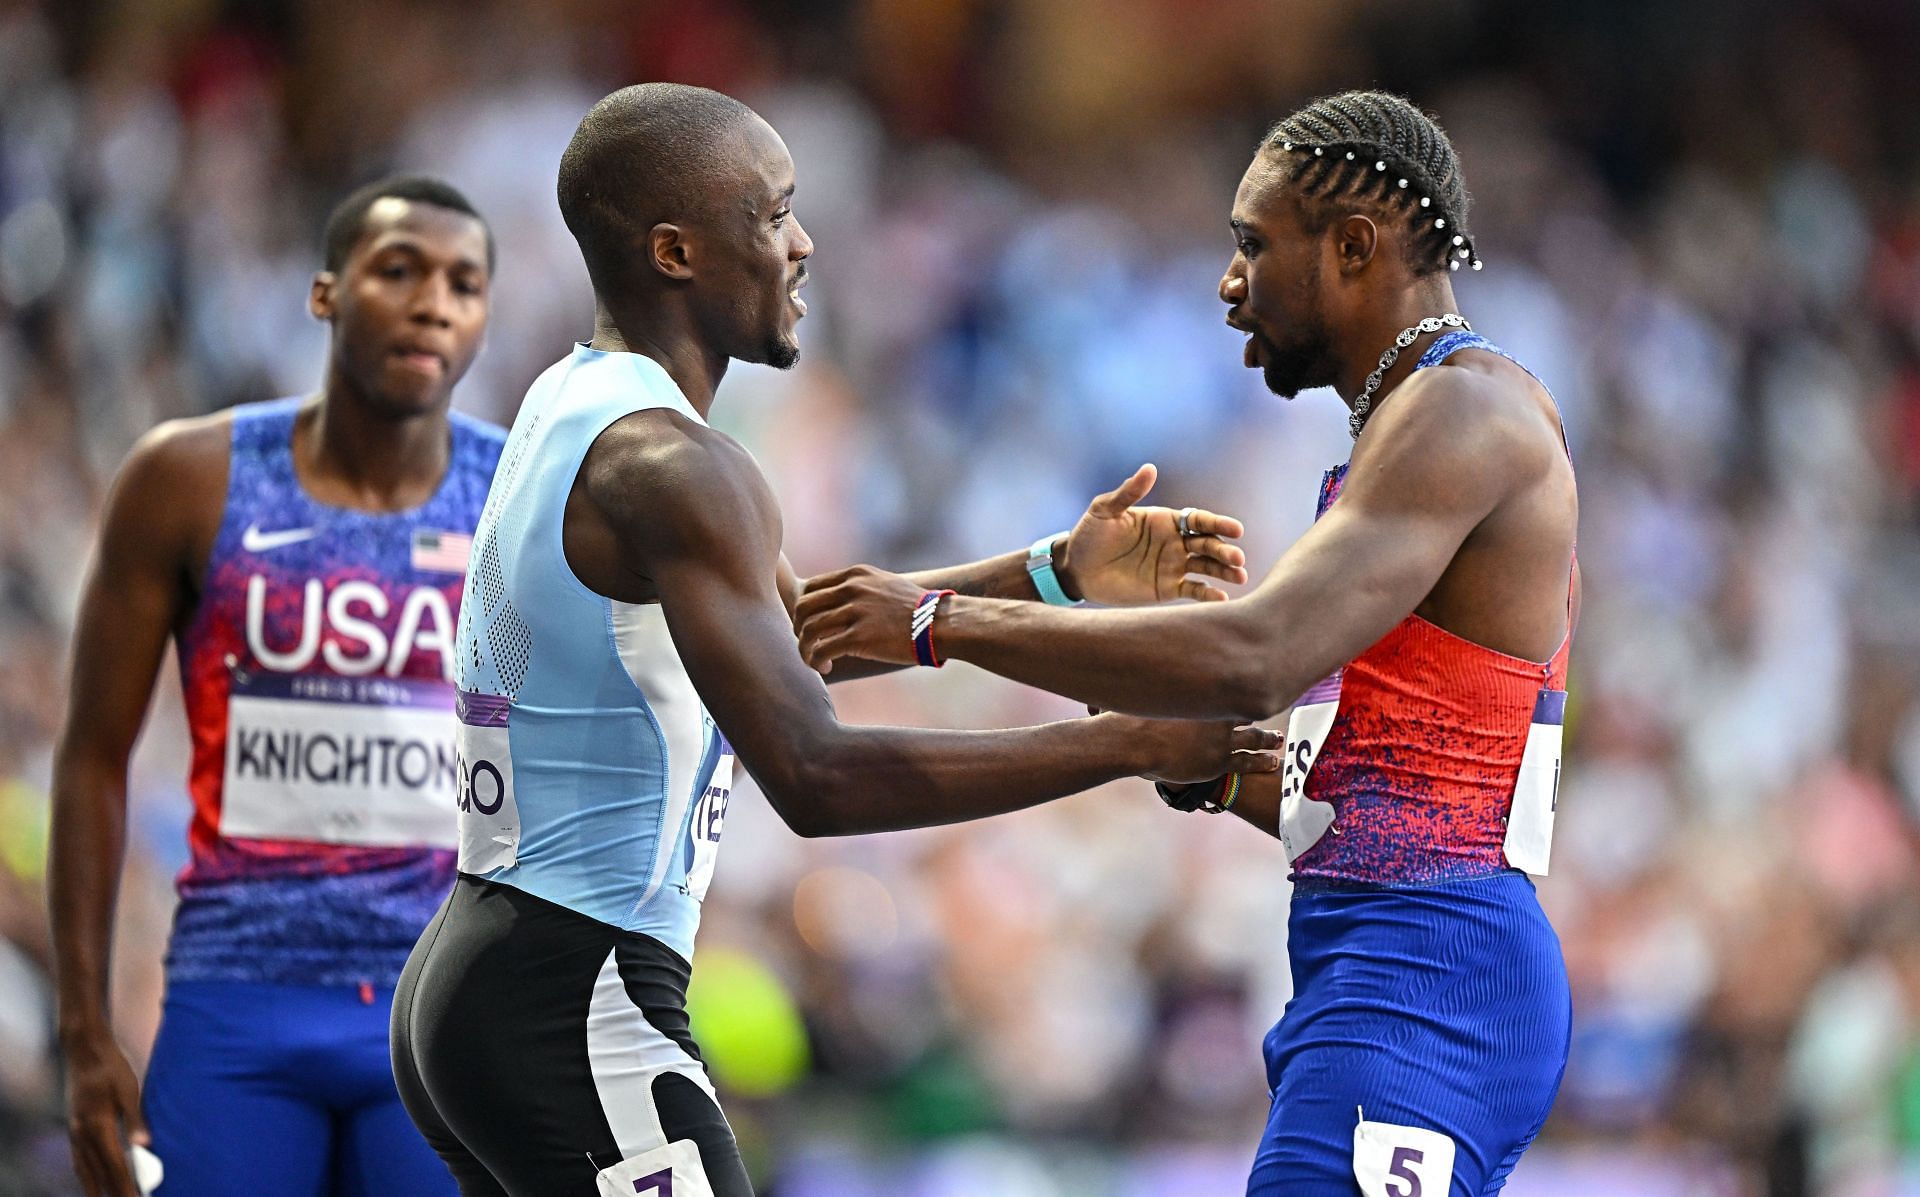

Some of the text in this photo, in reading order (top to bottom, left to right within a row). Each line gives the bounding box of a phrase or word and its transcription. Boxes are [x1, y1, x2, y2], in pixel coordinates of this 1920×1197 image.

[246, 573, 456, 682] USA
[236, 726, 457, 793] KNIGHTON
[1385, 1146, 1424, 1197] 5
